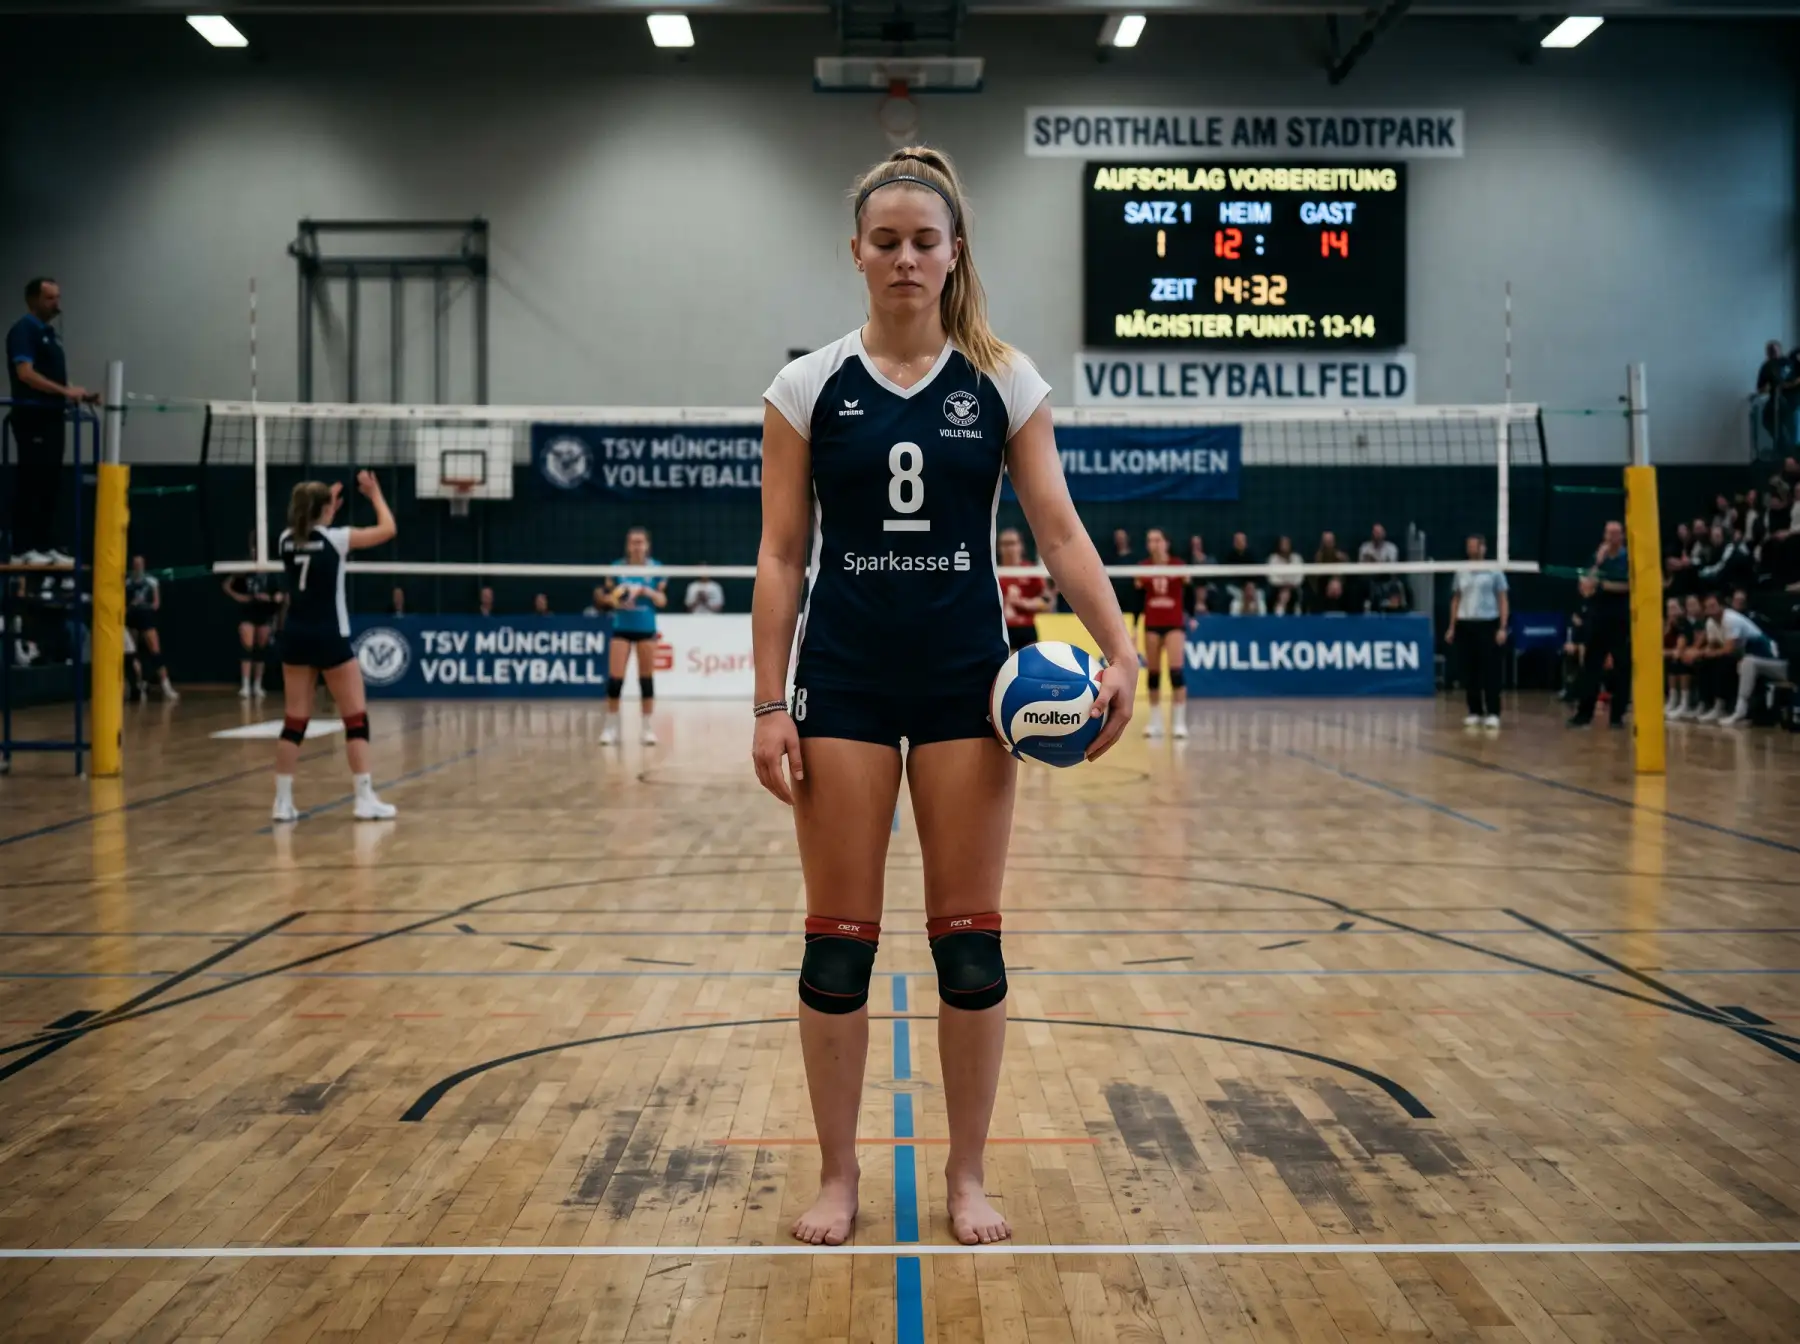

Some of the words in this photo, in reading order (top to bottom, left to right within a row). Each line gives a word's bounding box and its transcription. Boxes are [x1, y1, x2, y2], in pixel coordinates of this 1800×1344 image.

[1033, 116, 1223, 147] SPORTHALLE
[1231, 116, 1276, 147] AM
[1286, 116, 1456, 148] STADTPARK
[1094, 167, 1226, 191] AUFSCHLAG
[1229, 167, 1397, 191] VORBEREITUNG
[1124, 202, 1177, 224] SATZ
[1182, 202, 1192, 224] 1
[1219, 202, 1272, 224] HEIM
[1300, 202, 1356, 224] GAST
[1320, 230, 1349, 259] 14
[1151, 278, 1197, 301] ZEIT
[1214, 274, 1288, 306] 14:32
[1115, 309, 1233, 338] NÄCHSTER
[1236, 314, 1316, 338] PUNKT:
[1320, 314, 1376, 338] 13-14
[1085, 362, 1408, 398] VOLLEYBALLFELD
[601, 438, 646, 459] TSV
[651, 434, 763, 460] MÜNCHEN
[939, 429, 983, 439] VOLLEYBALL
[602, 464, 762, 488] VOLLEYBALL
[888, 441, 925, 514] 8
[294, 554, 311, 591] 7
[843, 551, 949, 575] Sparkasse
[420, 631, 469, 654] TSV
[474, 626, 605, 655] MÜNCHEN
[1184, 640, 1419, 670] WILLKOMMEN
[420, 659, 604, 684] VOLLEYBALL
[795, 687, 808, 721] 8
[1023, 711, 1081, 725] molten
